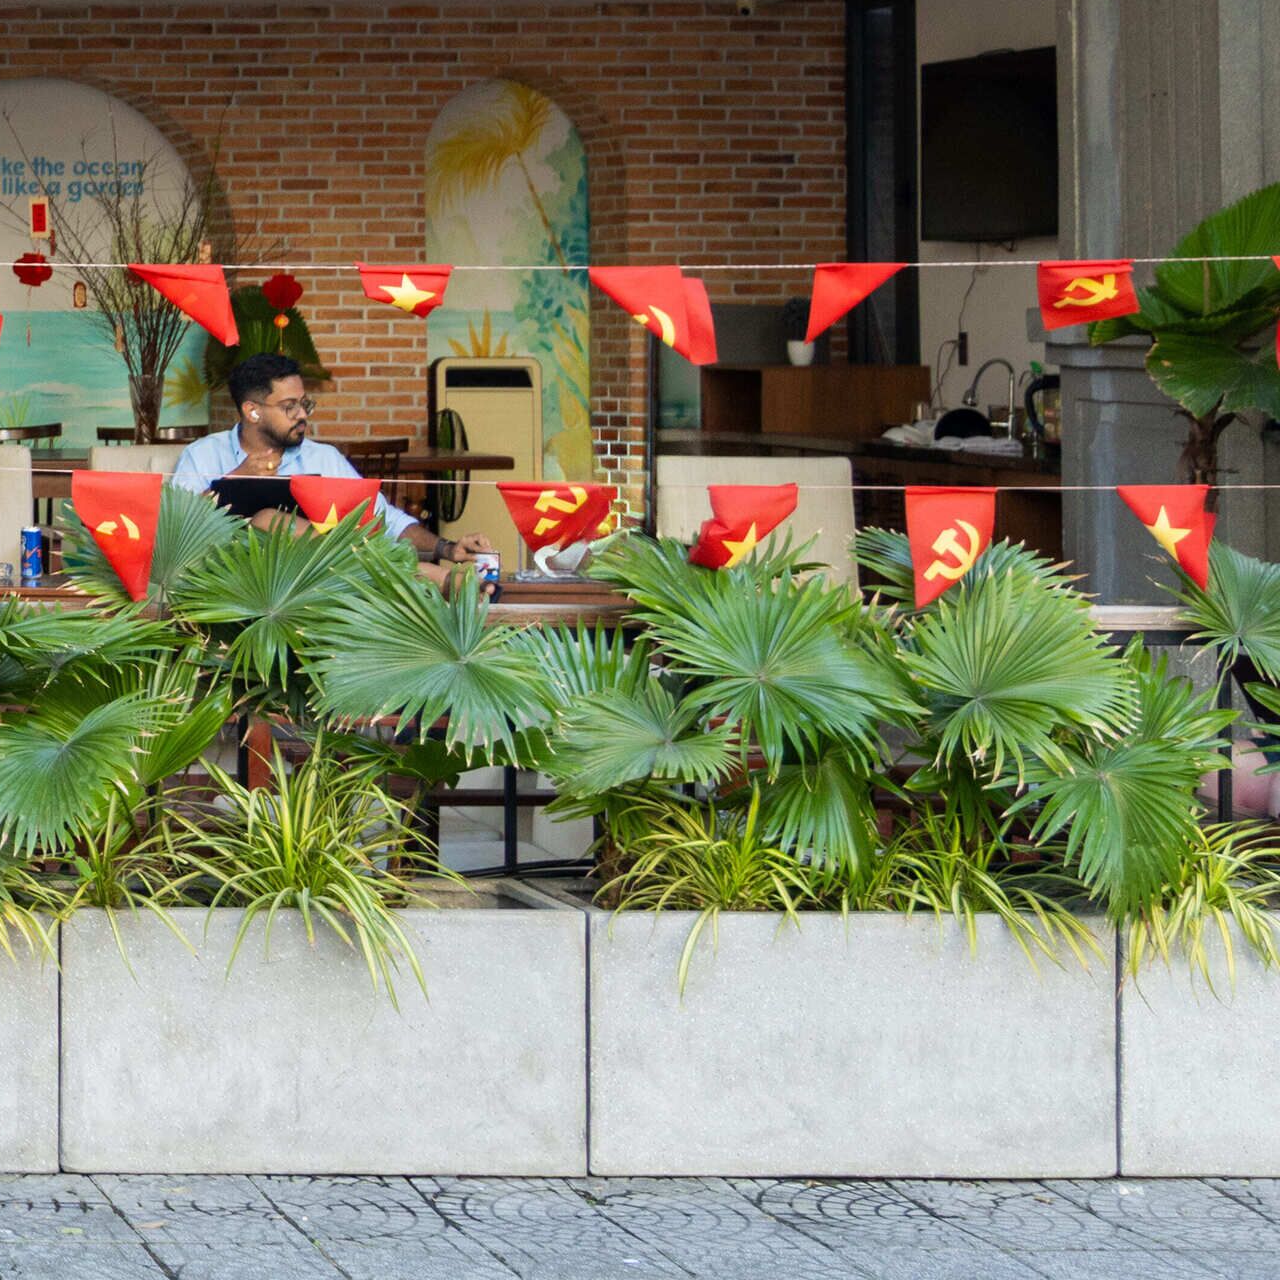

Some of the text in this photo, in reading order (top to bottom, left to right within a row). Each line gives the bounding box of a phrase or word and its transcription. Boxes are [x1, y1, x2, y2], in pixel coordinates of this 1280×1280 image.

[32, 156, 65, 177] the
[72, 160, 145, 177] ocean
[1, 177, 40, 196] like
[44, 181, 61, 196] a
[67, 178, 145, 202] garden
